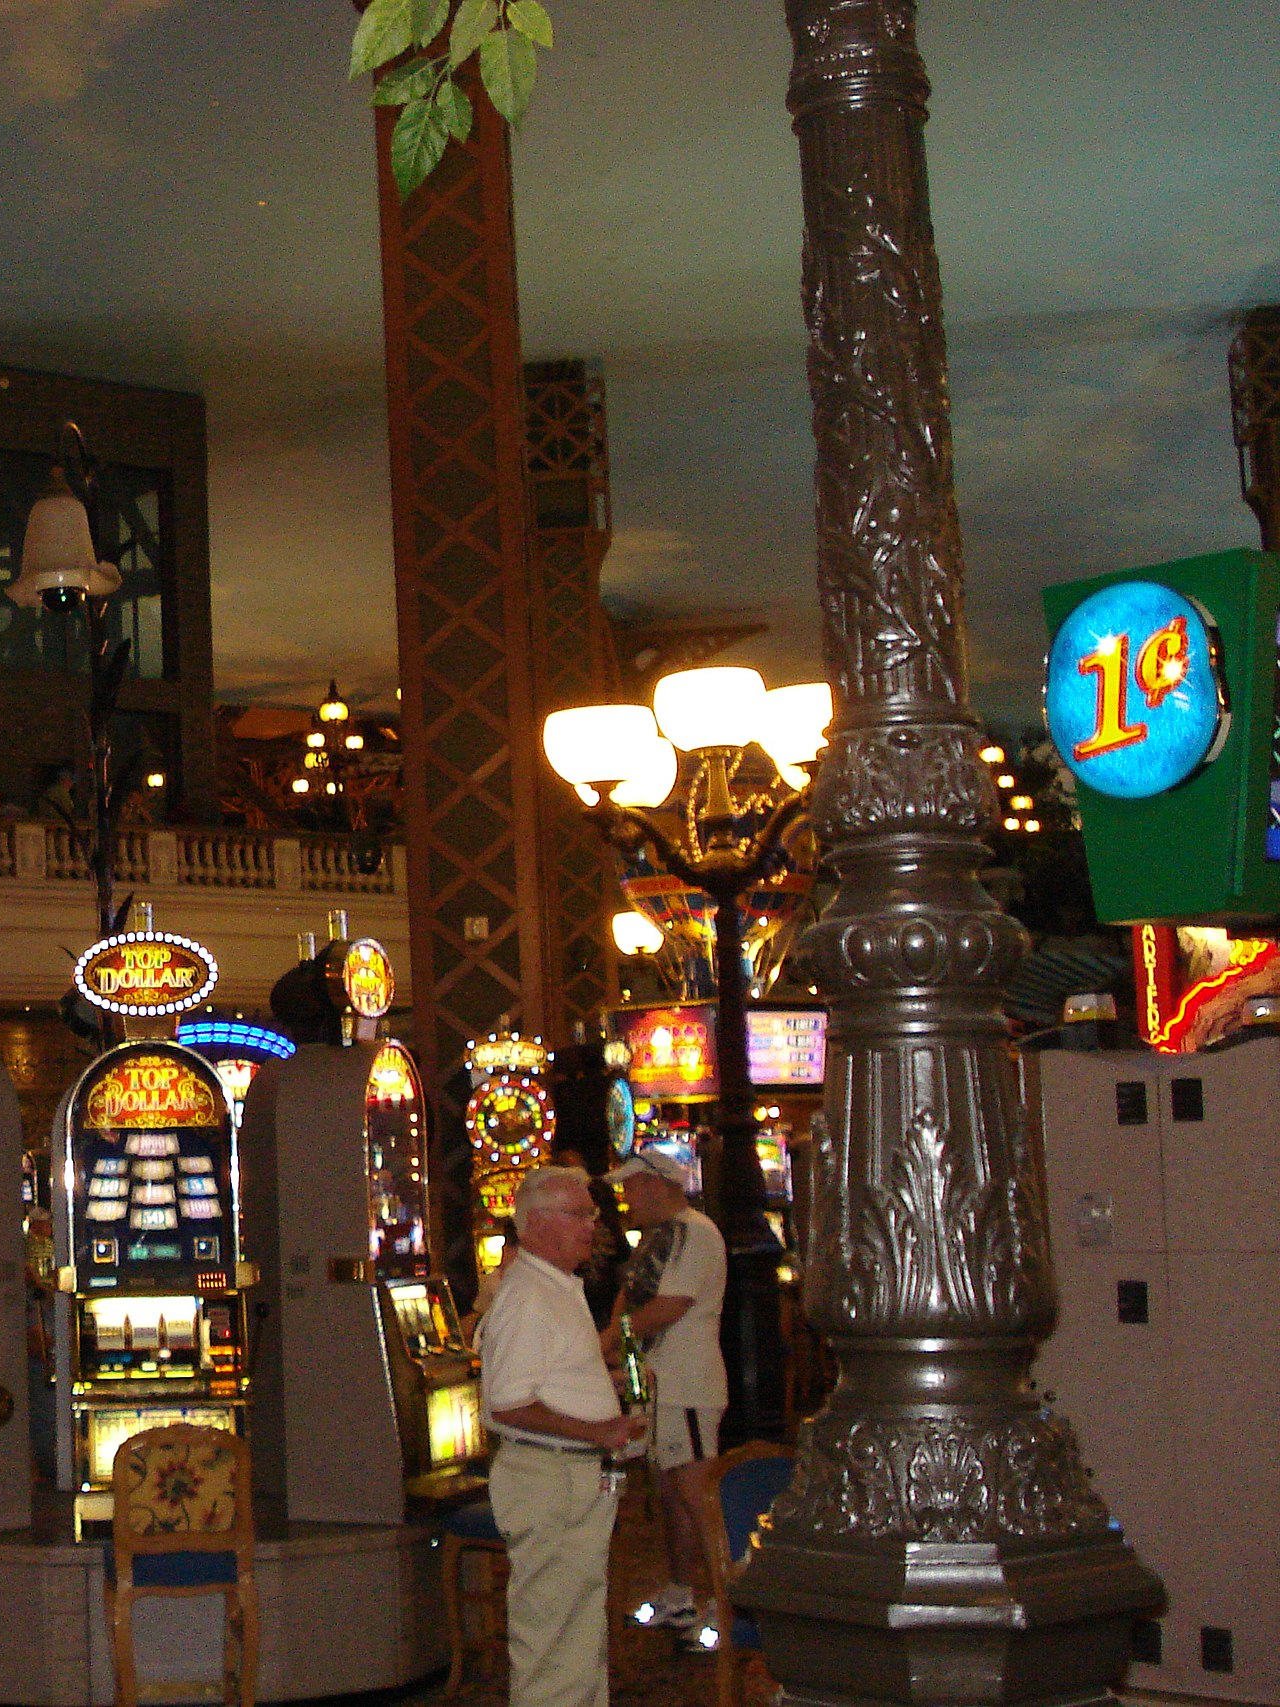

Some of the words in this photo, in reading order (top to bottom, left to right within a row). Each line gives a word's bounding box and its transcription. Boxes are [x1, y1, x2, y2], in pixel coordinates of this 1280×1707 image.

[1074, 617, 1189, 762] 1¢
[121, 948, 171, 969] TOP
[98, 966, 195, 994] DOLLAR
[124, 1067, 178, 1090] TOP
[105, 1089, 198, 1117] DOLLAR
